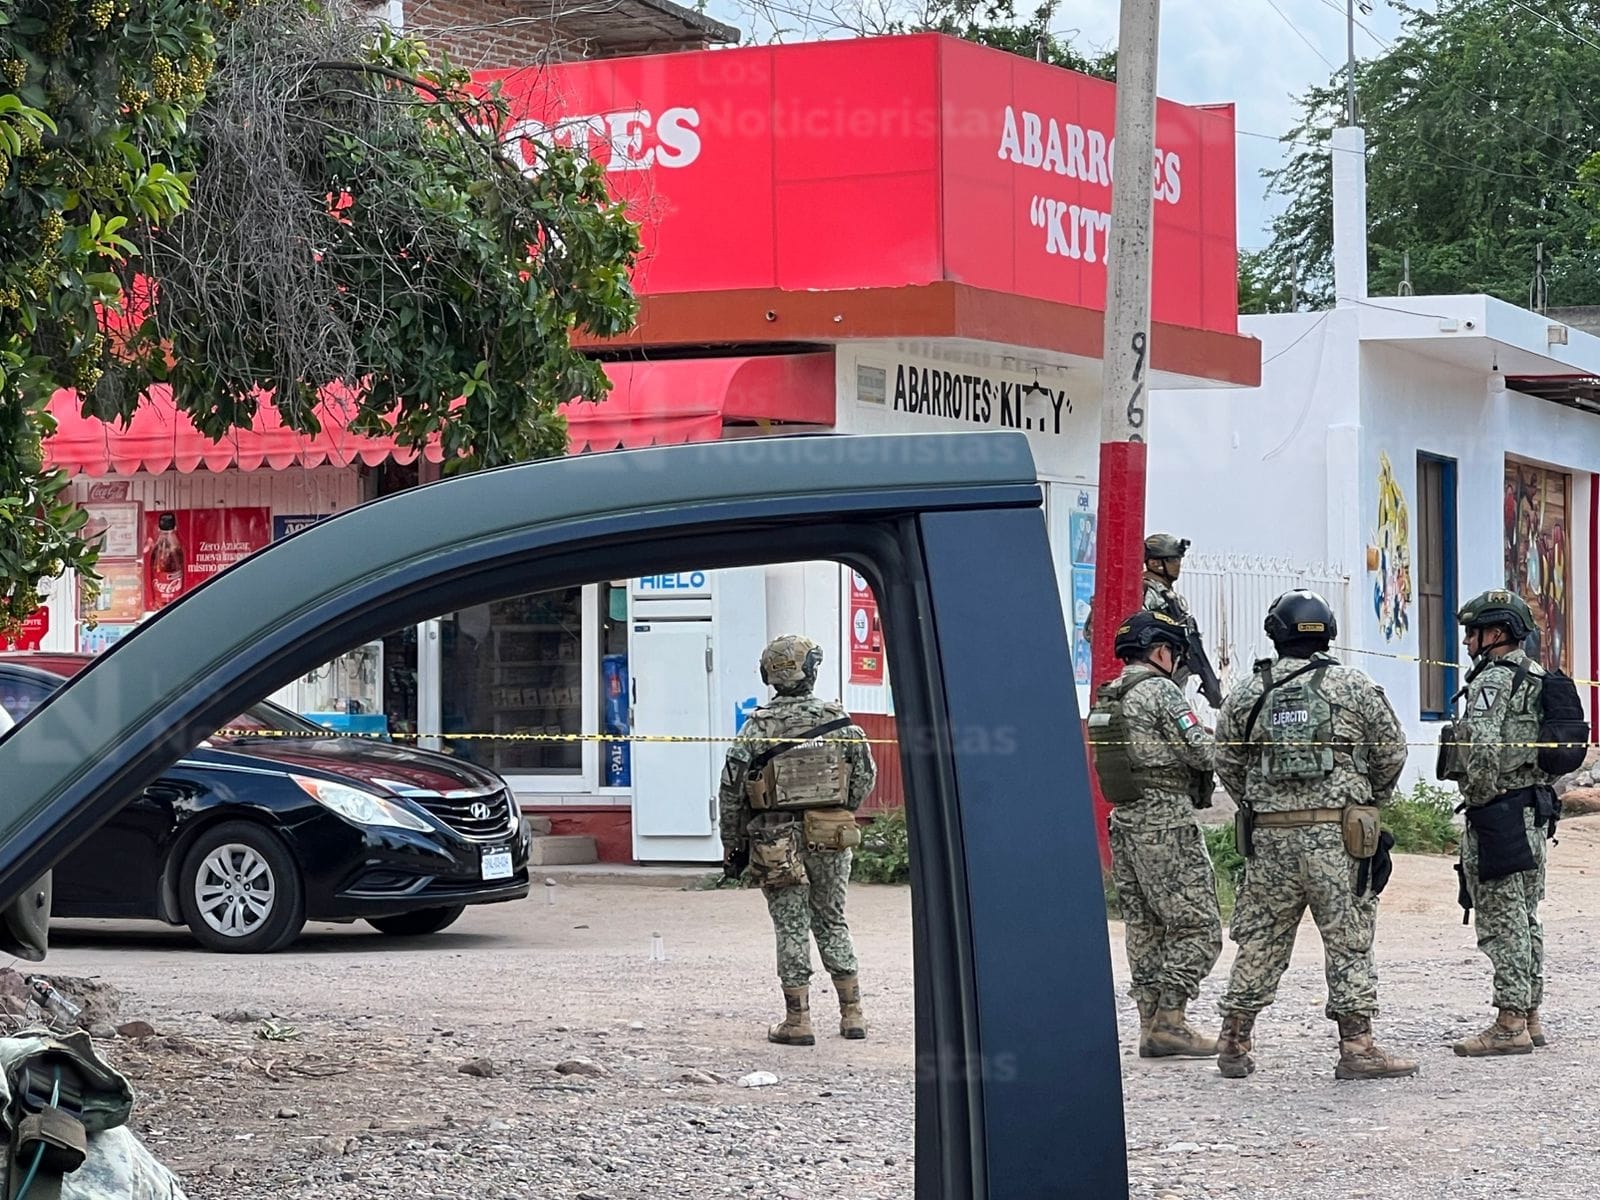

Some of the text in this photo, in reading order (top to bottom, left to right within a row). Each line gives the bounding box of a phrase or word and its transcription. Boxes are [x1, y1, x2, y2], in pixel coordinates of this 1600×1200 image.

[498, 107, 701, 178] OTES
[998, 105, 1181, 204] ABARRES
[893, 363, 991, 423] ABARROTES
[200, 542, 220, 551] Zero
[187, 563, 217, 573] mismo
[640, 572, 705, 589] HIELO
